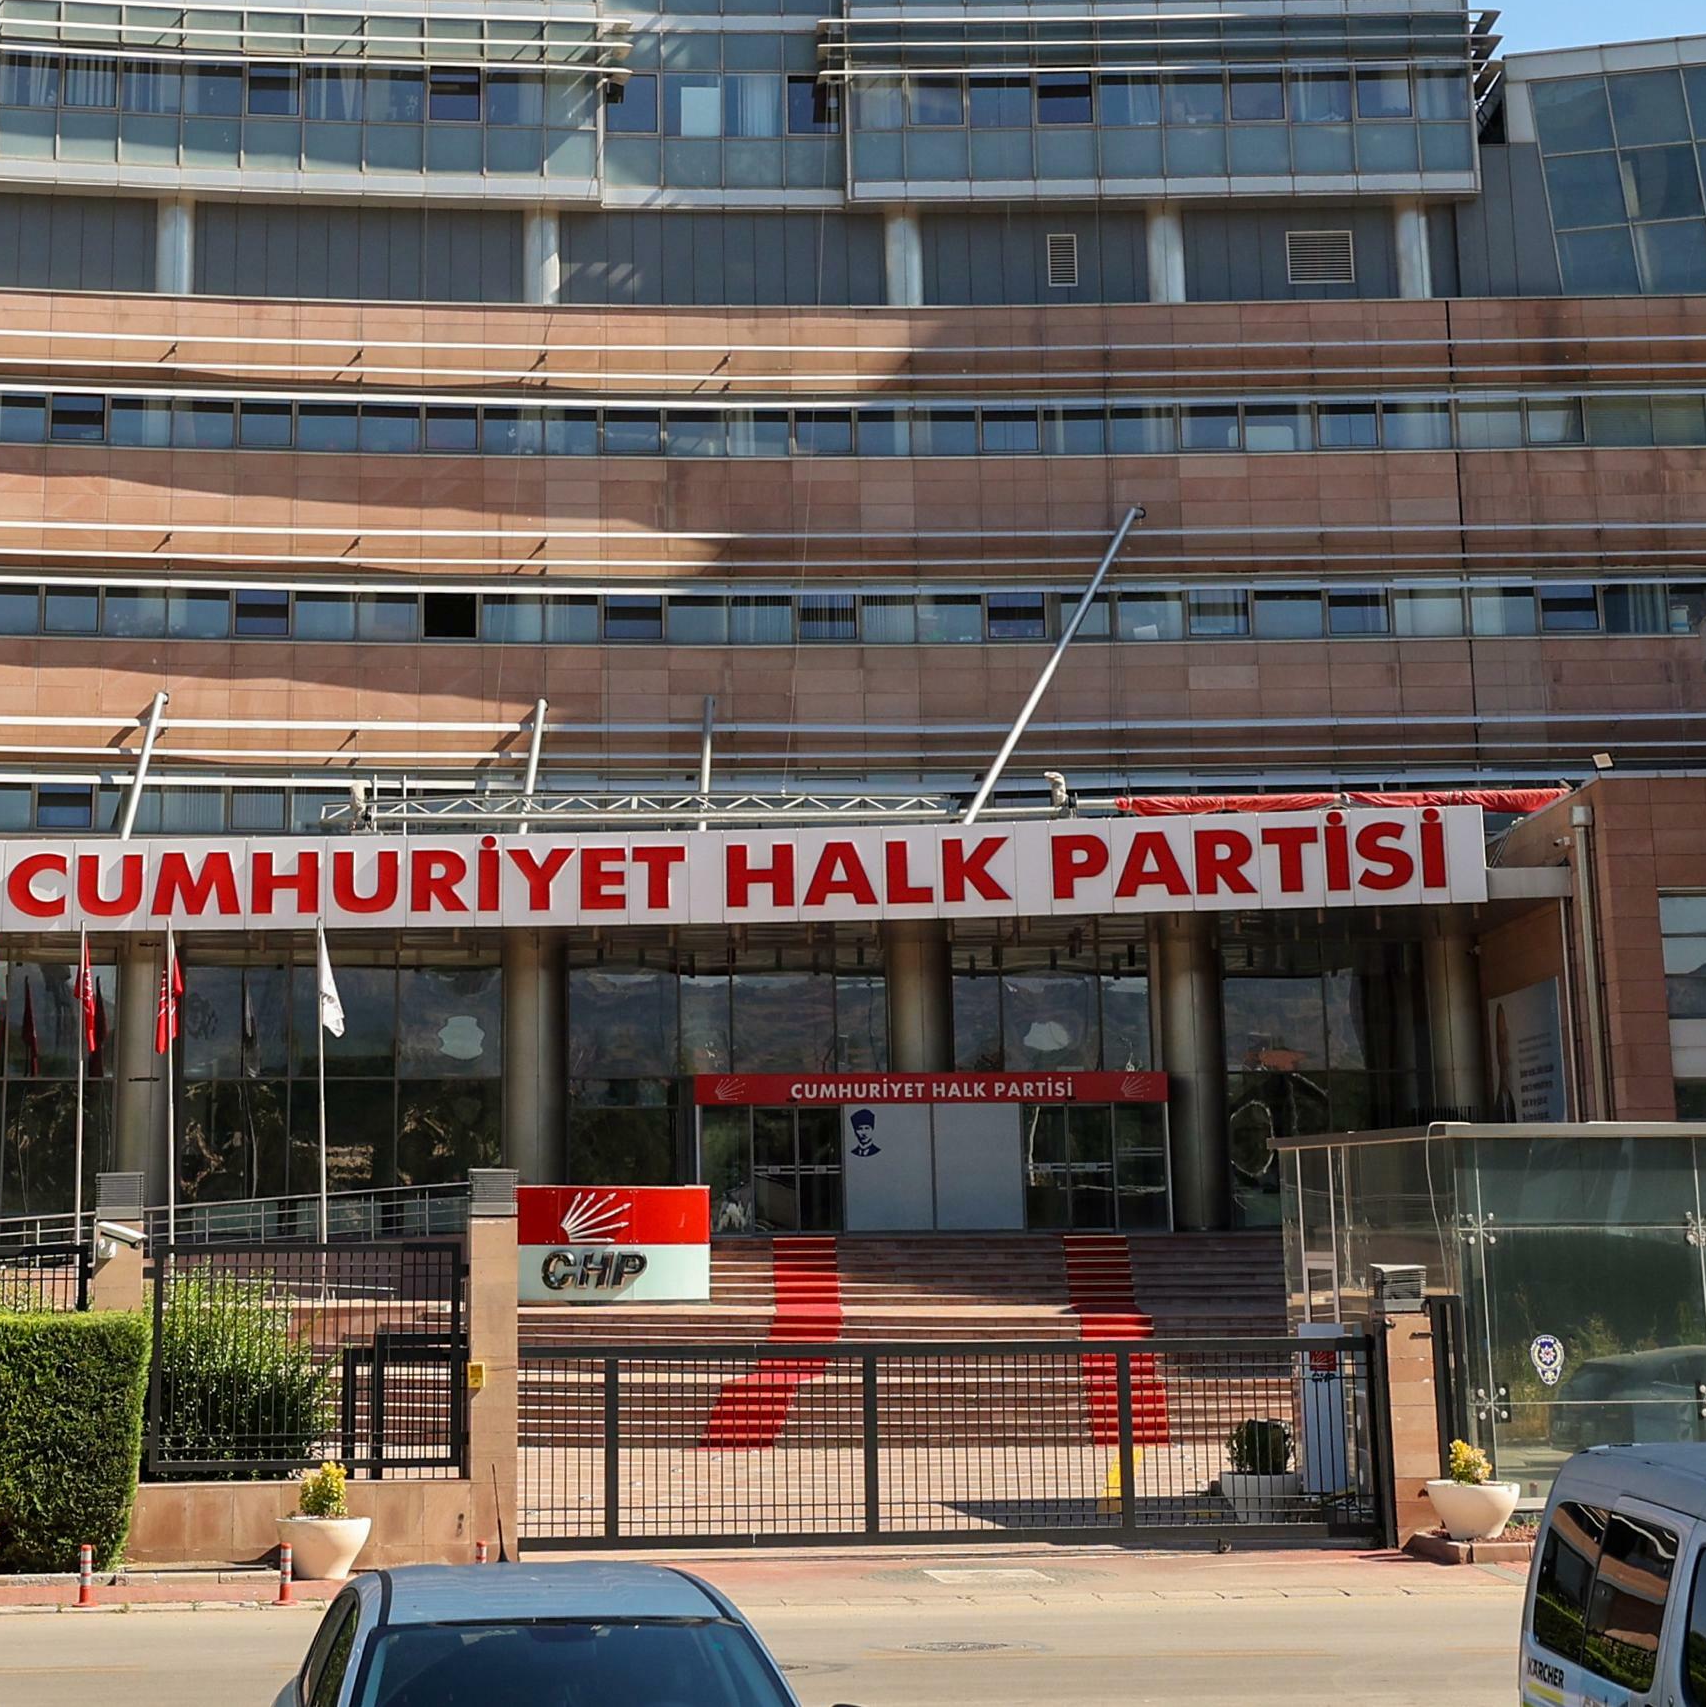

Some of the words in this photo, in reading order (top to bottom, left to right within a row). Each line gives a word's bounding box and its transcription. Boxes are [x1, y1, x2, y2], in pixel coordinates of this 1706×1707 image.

[7, 835, 686, 918] CUMHURİYET
[726, 836, 1013, 908] HALK
[1051, 807, 1447, 900] PARTİSİ
[791, 1078, 925, 1099] CUMHURİYET
[932, 1082, 986, 1097] HALK
[994, 1077, 1072, 1097] PARTİSİ
[542, 1250, 647, 1290] CHP
